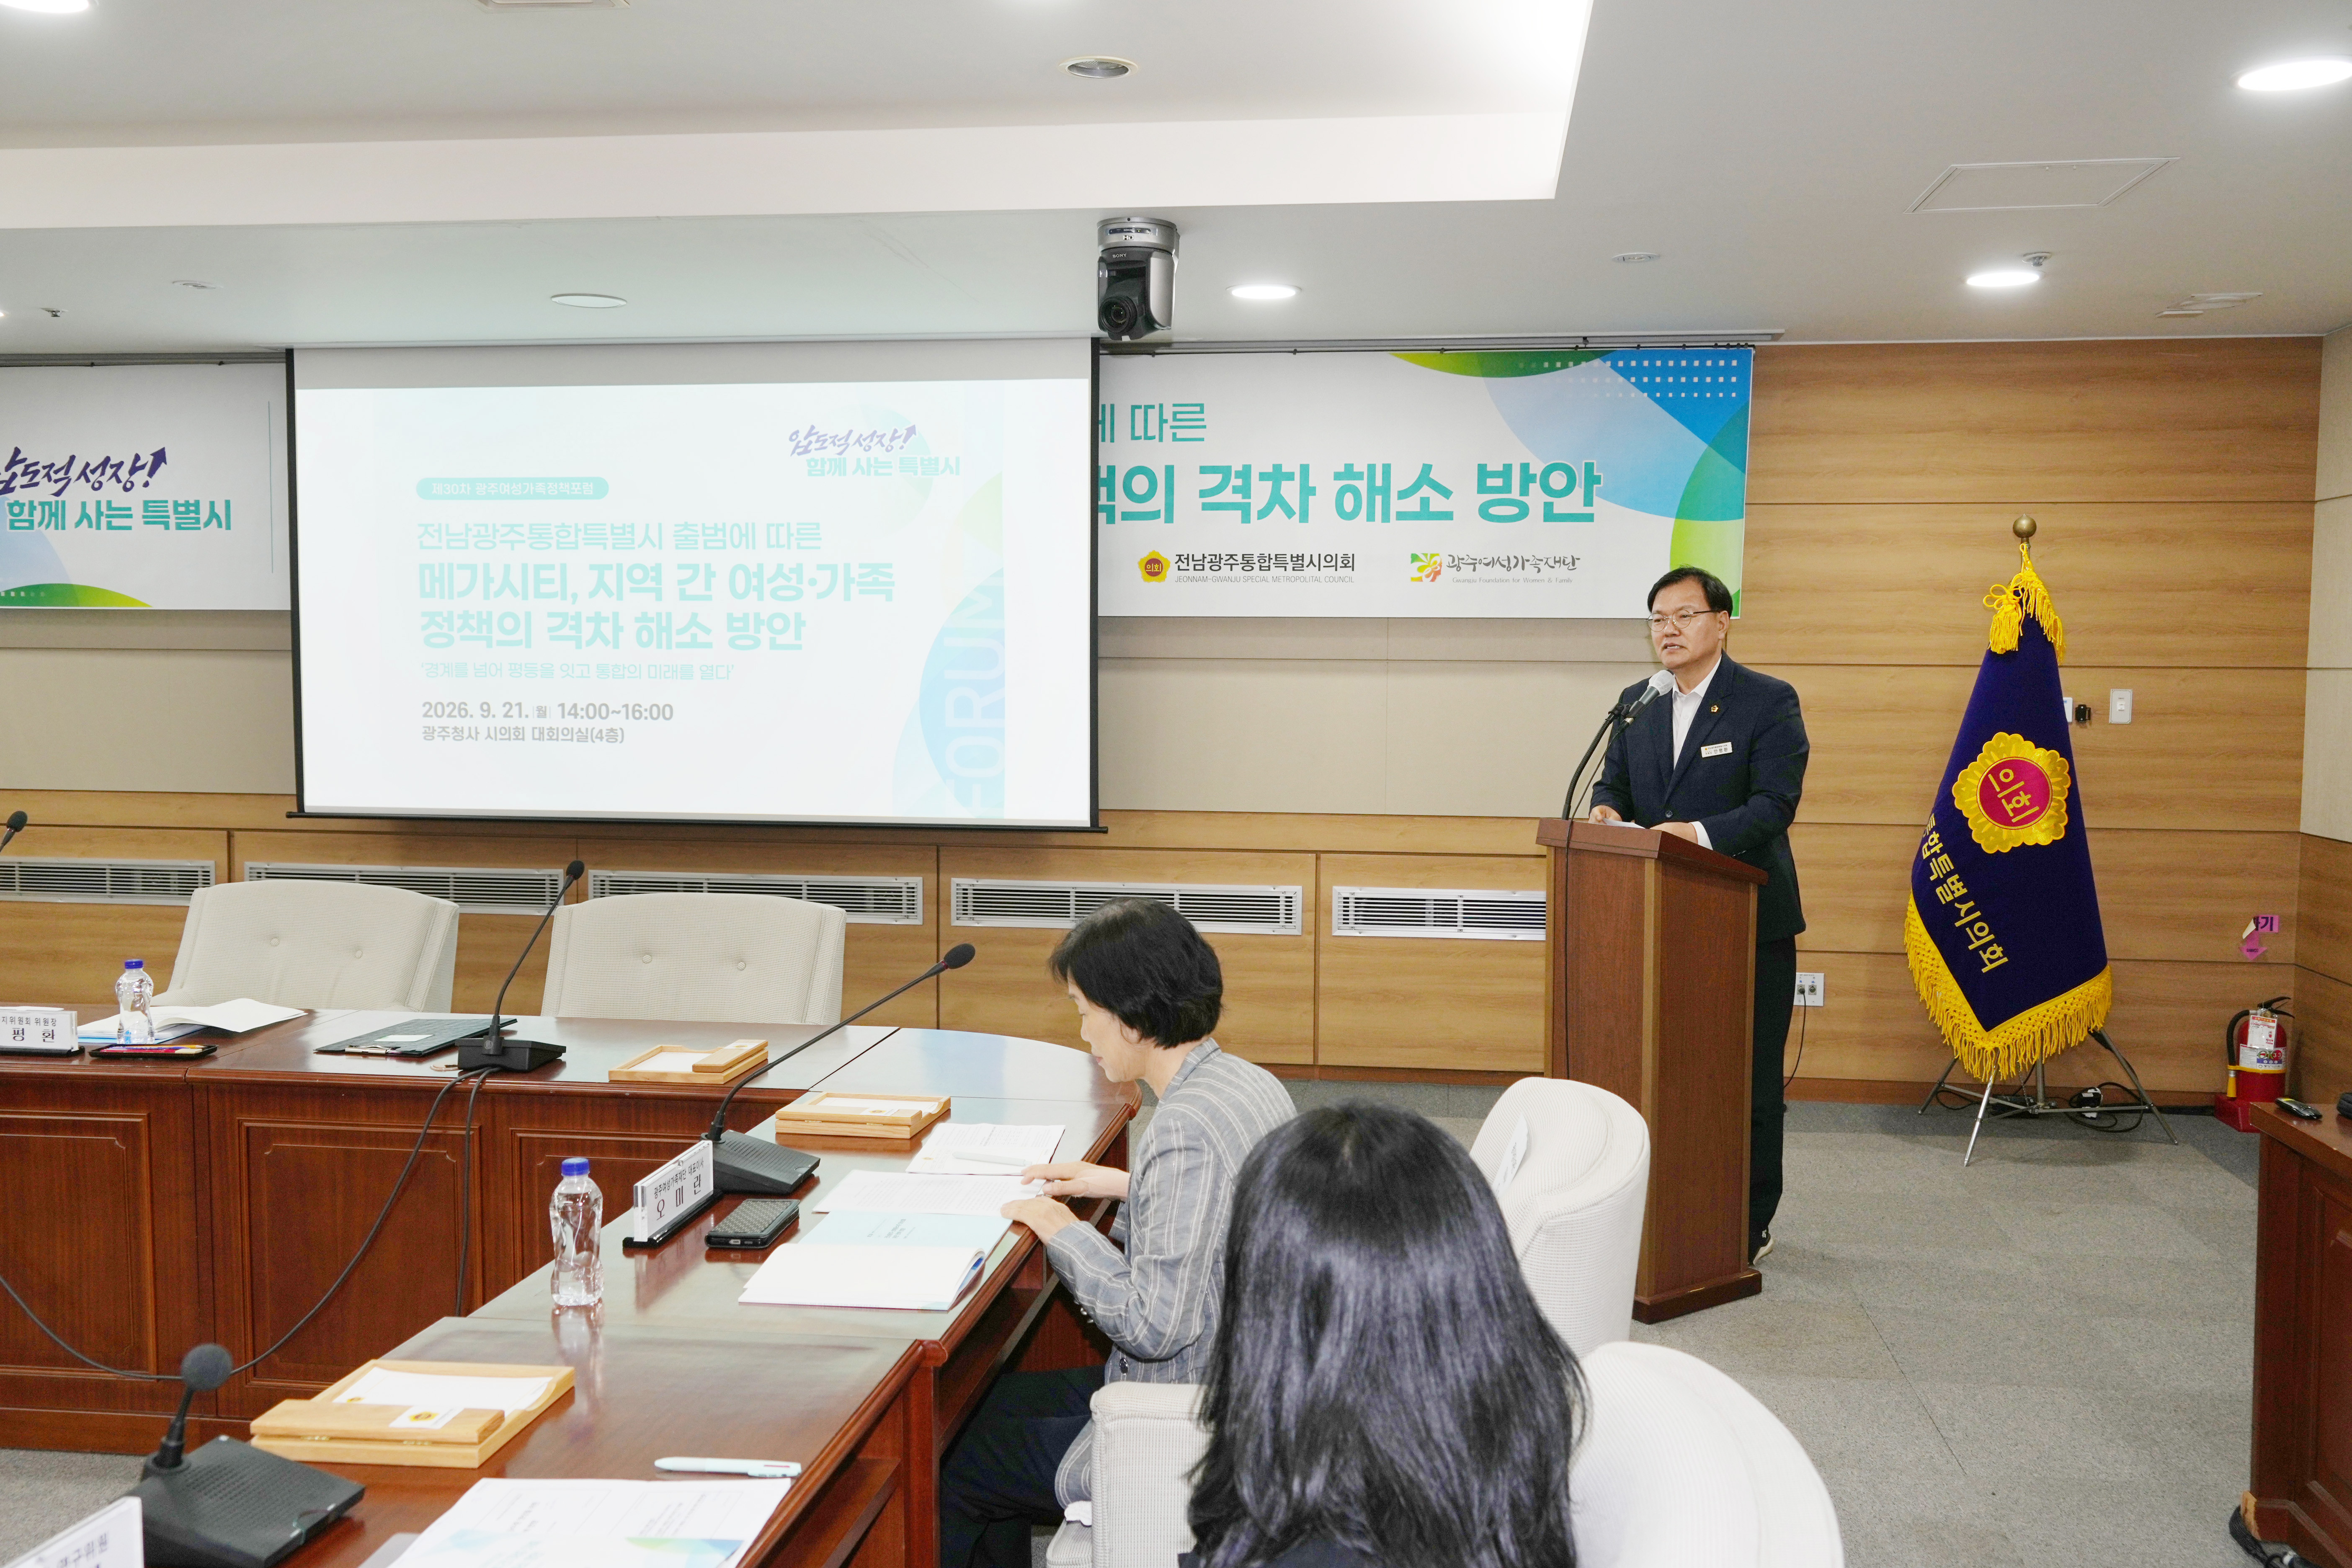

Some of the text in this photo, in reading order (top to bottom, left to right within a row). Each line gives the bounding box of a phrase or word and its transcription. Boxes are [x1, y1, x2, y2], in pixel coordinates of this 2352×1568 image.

[1130, 403, 1207, 443] 따른
[789, 424, 854, 457] 압도적
[806, 456, 960, 477] 함께 사는 특별시
[432, 482, 593, 495] 제30차 광주여성가족정책포럼
[1199, 463, 1317, 524] 격차
[1333, 463, 1454, 524] 해소
[1476, 461, 1602, 523] 방안
[7, 499, 232, 531] 함께 사는 특별시
[418, 522, 823, 551] 전남광주통합특별시 출범에 따른
[1145, 563, 1162, 573] 의회
[1175, 553, 1355, 572] 전남광주통합특별시의회
[1446, 554, 1581, 574] 광주여성가족재단
[419, 563, 895, 605] 메가시티, 지역 간 여성·가족
[420, 610, 807, 651] 정책의 격차 해소 방안
[474, 662, 503, 679] 넘어
[508, 663, 555, 679] 평등을
[560, 663, 591, 679] 잇고
[596, 663, 642, 680] 통합의
[647, 664, 695, 680] 미래를
[422, 702, 474, 719] 2026.
[480, 702, 496, 719] 9.
[502, 702, 529, 719] 21.
[557, 703, 674, 721] 14:00~16:00
[422, 726, 625, 744] 광주청사 시의회 대회의실(4층)
[1988, 769, 2040, 823] 의회
[34, 1017, 57, 1027] 위원장
[654, 1157, 704, 1199] 광주여성가족재단 대표이사
